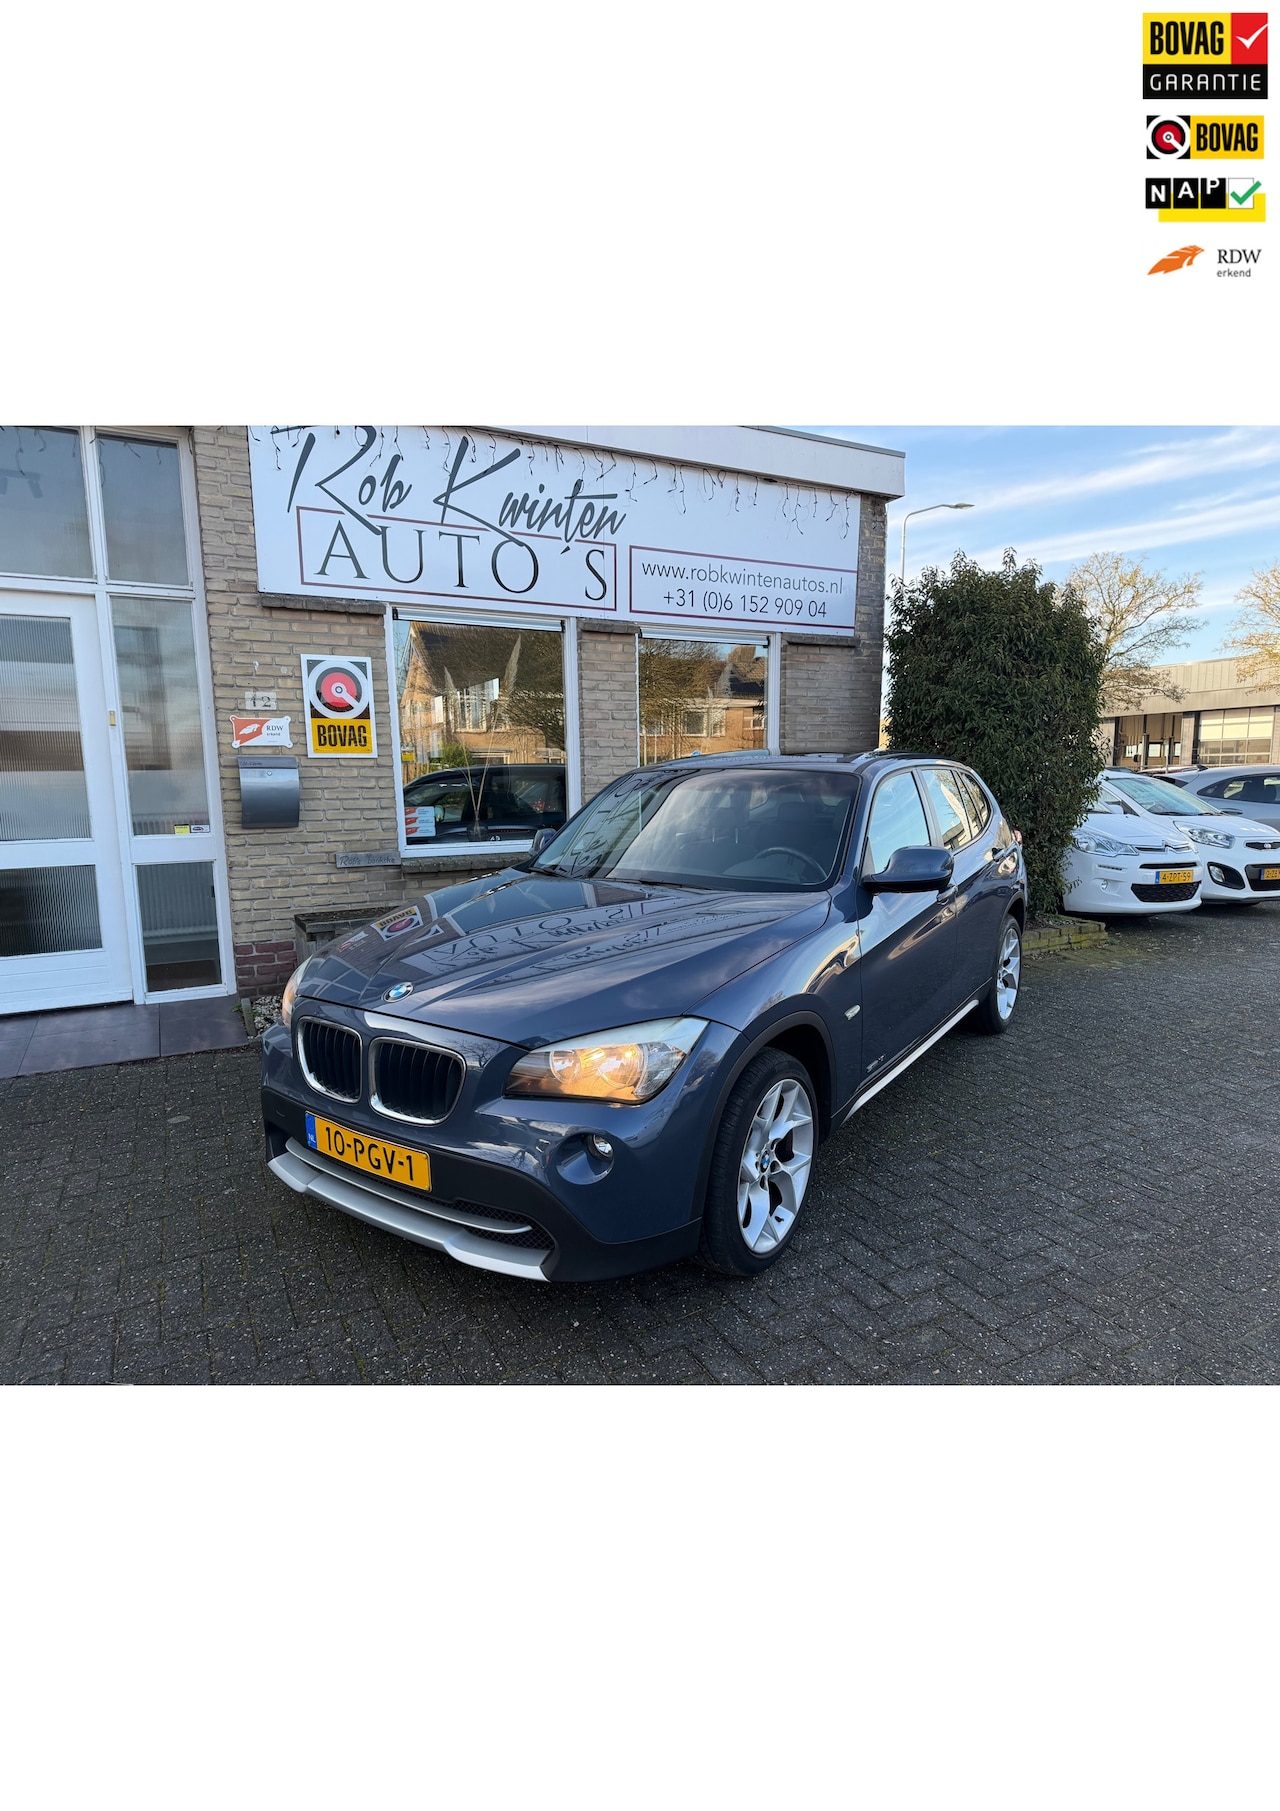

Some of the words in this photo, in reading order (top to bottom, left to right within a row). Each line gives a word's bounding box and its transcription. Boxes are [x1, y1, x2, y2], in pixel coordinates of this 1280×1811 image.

[270, 425, 412, 536] Rob
[432, 436, 627, 547] Kwinten
[642, 562, 843, 594] www.robkwintenautos.nl
[663, 589, 695, 607] +31
[703, 591, 733, 613] (0)6
[741, 595, 769, 614] 152
[775, 598, 803, 616] 909
[808, 600, 827, 617] 04
[317, 725, 367, 748] BOVAG
[1162, 872, 1191, 882] 4-ZPT-59
[325, 1126, 414, 1182] 10-PGV-1
